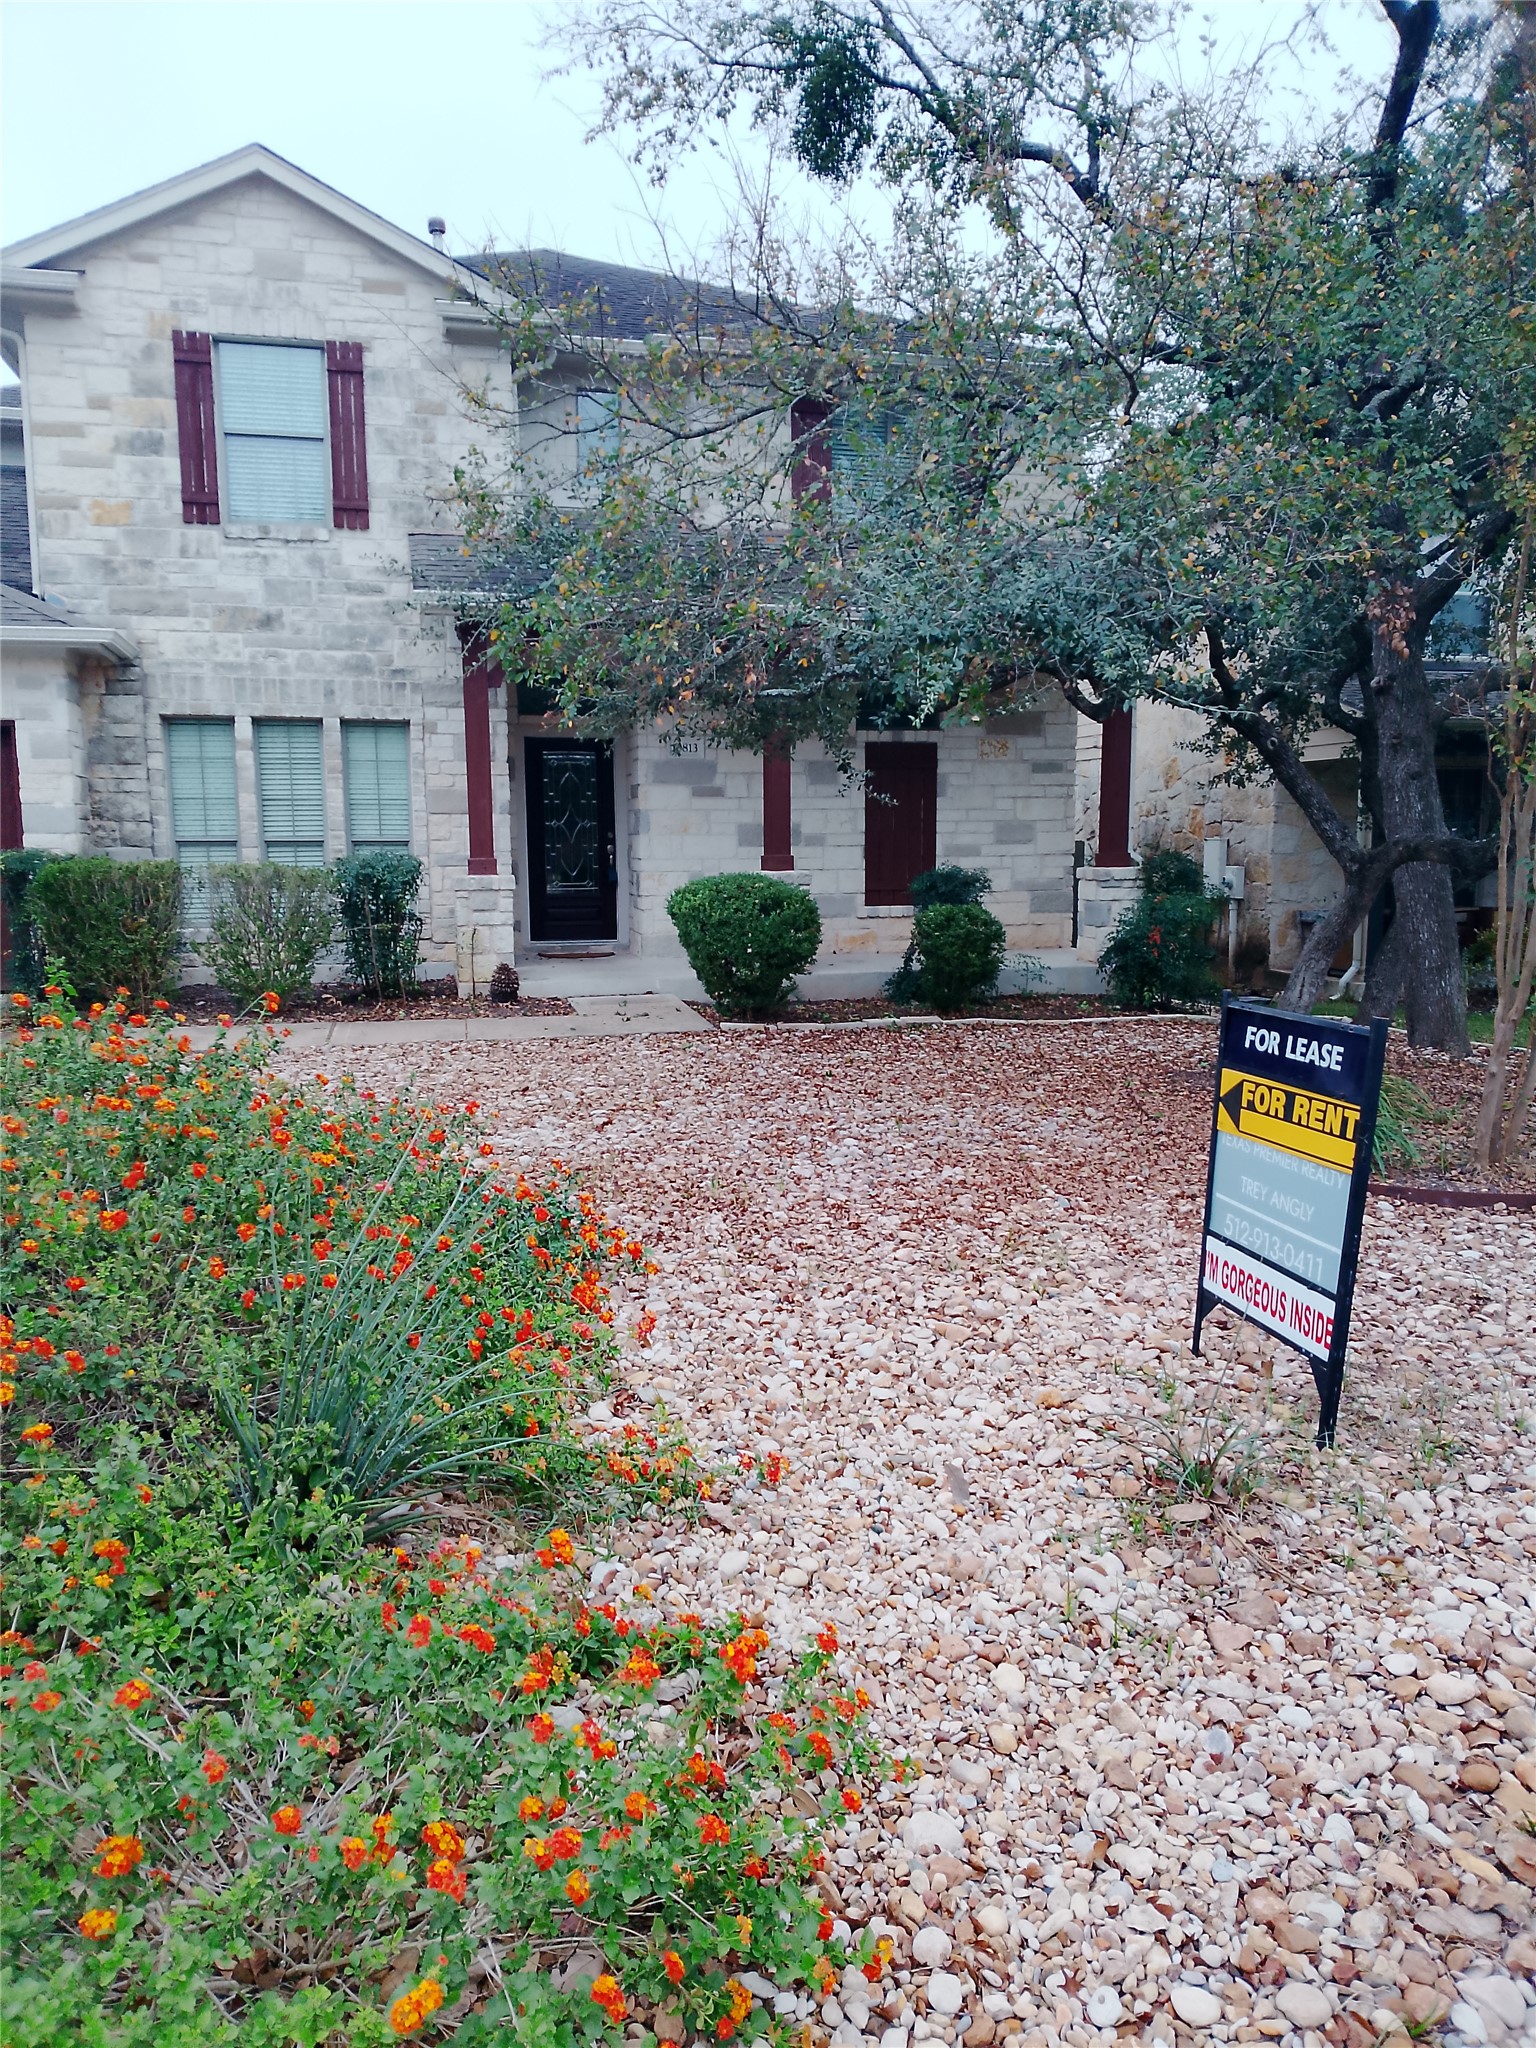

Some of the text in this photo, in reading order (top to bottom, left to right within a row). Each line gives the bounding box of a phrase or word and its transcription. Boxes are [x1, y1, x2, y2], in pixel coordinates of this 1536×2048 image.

[1244, 1025, 1345, 1071] FOR LEASE
[1241, 1081, 1361, 1140] FOR RENT
[1222, 1133, 1345, 1189] TEXAS PREMIER REALTY
[1240, 1175, 1315, 1222] TREY ANGLY
[1224, 1214, 1323, 1282] 512-913-0411
[1221, 1260, 1287, 1323] GORGEOUS
[1289, 1297, 1335, 1350] INSIDE
